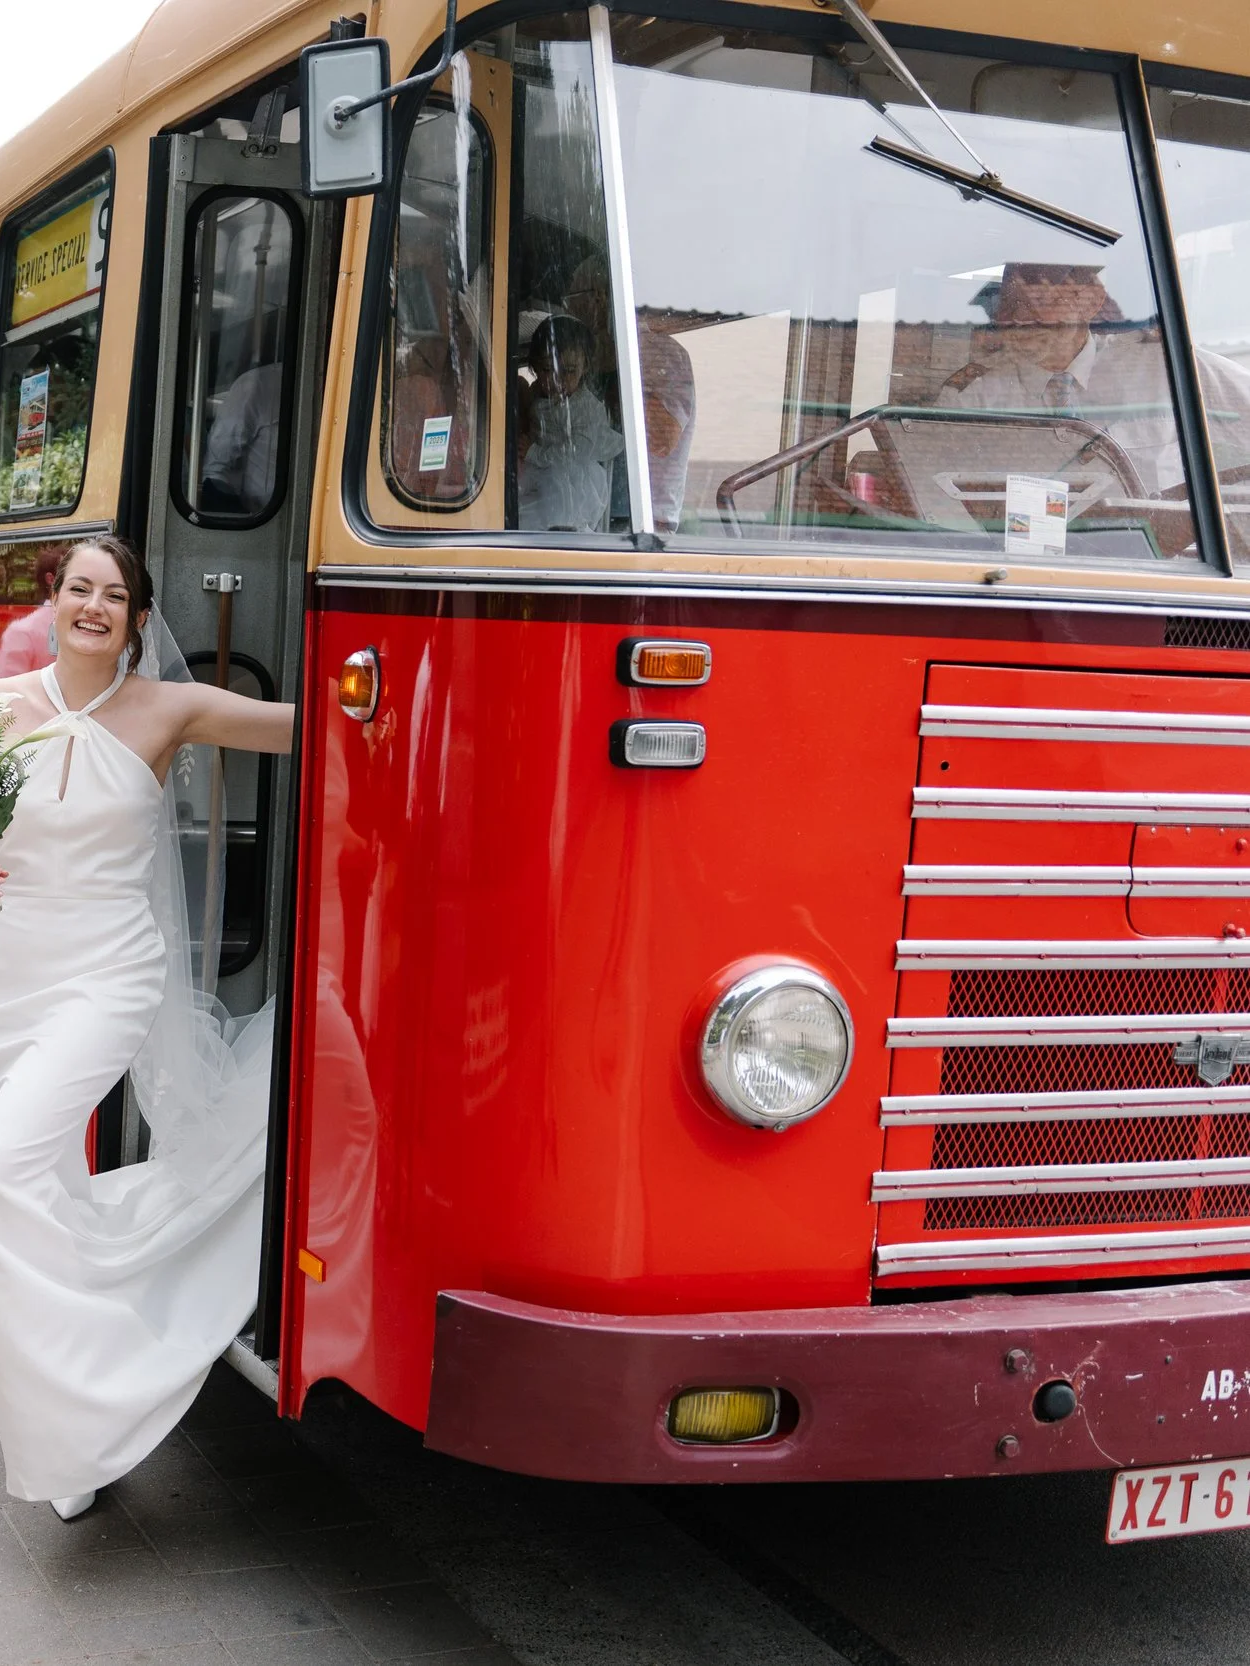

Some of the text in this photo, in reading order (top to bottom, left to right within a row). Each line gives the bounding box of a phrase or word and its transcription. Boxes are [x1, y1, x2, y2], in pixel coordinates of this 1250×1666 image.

[15, 231, 86, 294] SERVICE SPECIAL
[1119, 1468, 1250, 1531] XZT-6
